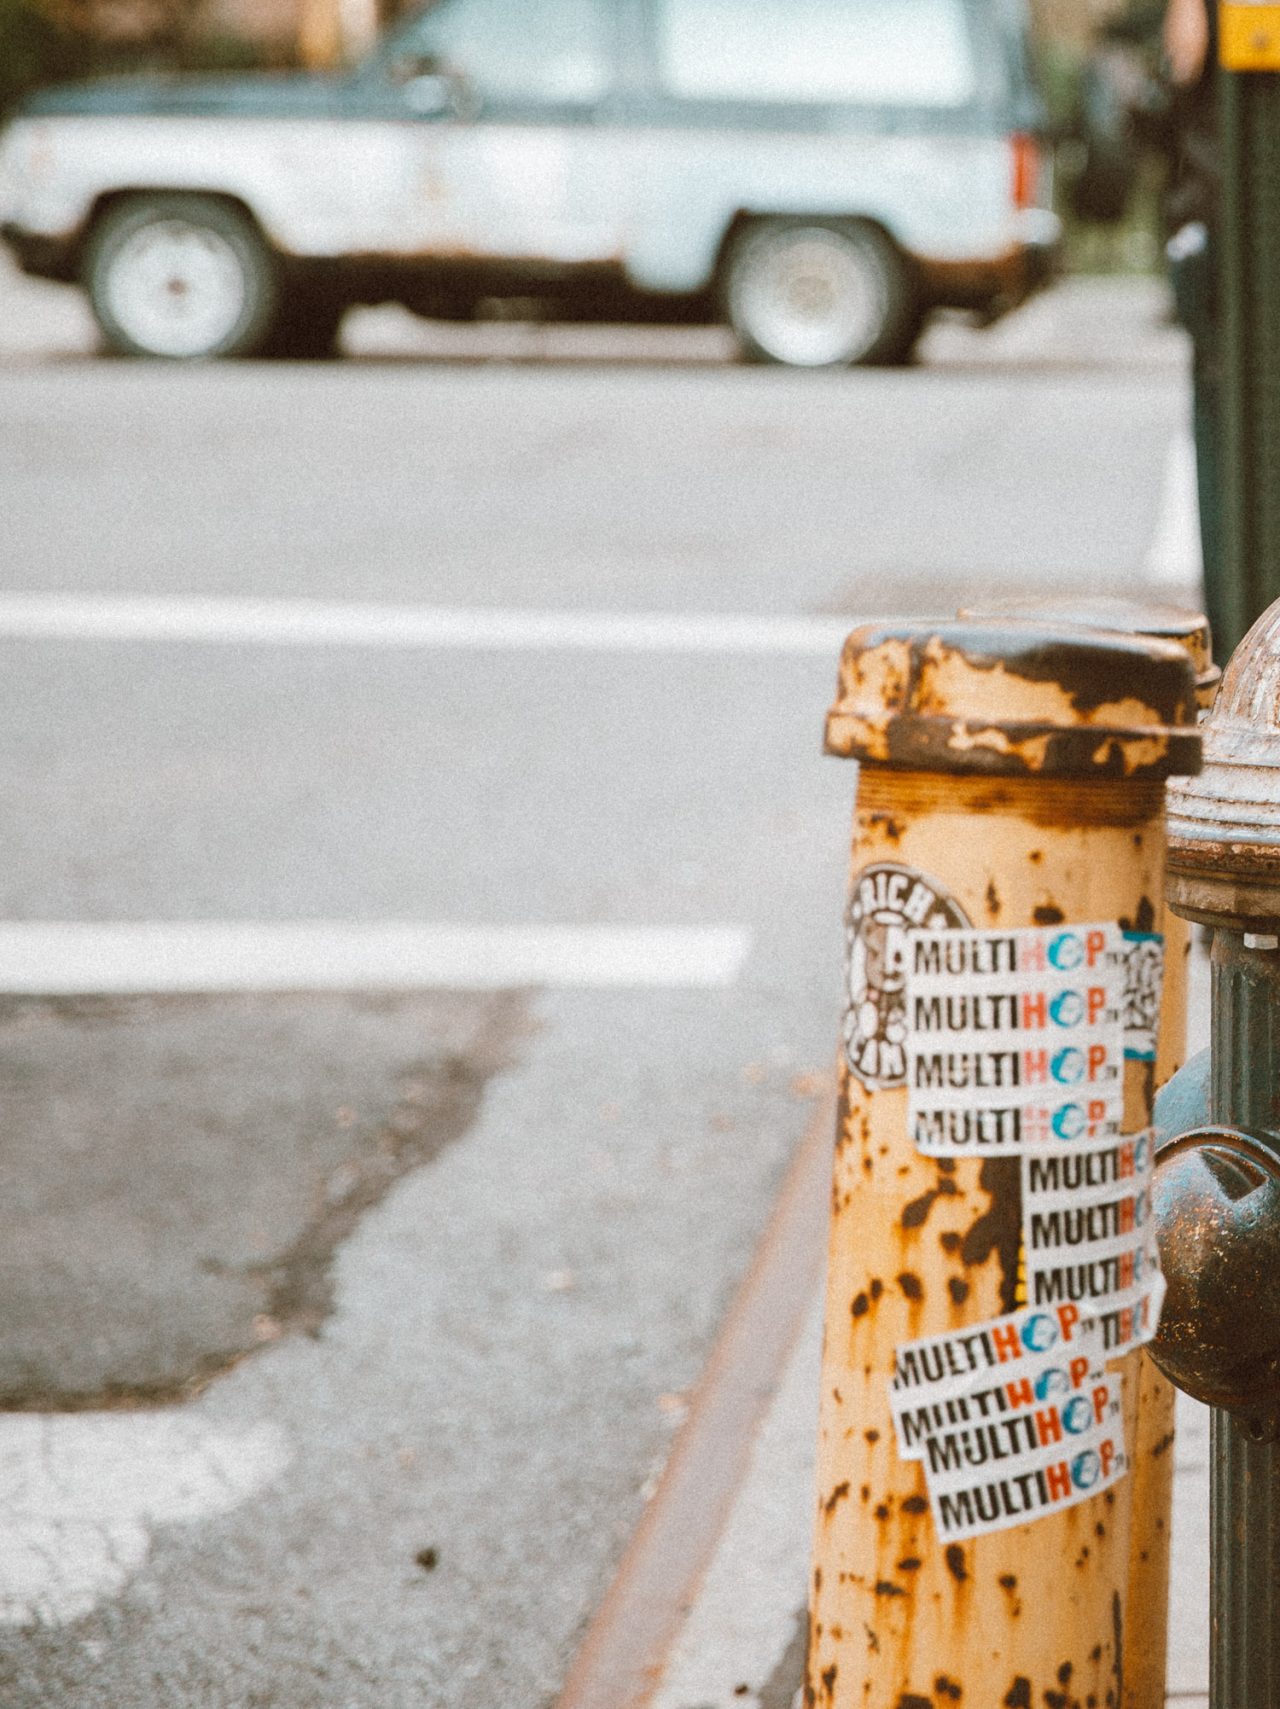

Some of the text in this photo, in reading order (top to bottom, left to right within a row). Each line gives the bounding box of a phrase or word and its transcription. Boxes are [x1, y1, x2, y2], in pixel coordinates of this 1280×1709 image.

[915, 931, 1105, 976] MULTIHOP
[915, 987, 1106, 1031] MULTIHOP
[915, 1045, 1107, 1089] MULTIHOP
[915, 1101, 1106, 1145] MULTIHOP
[894, 1303, 1079, 1390] MULTIHOP
[926, 1386, 1109, 1474] MULTIHOP
[938, 1439, 1114, 1531] MULTIHOP
